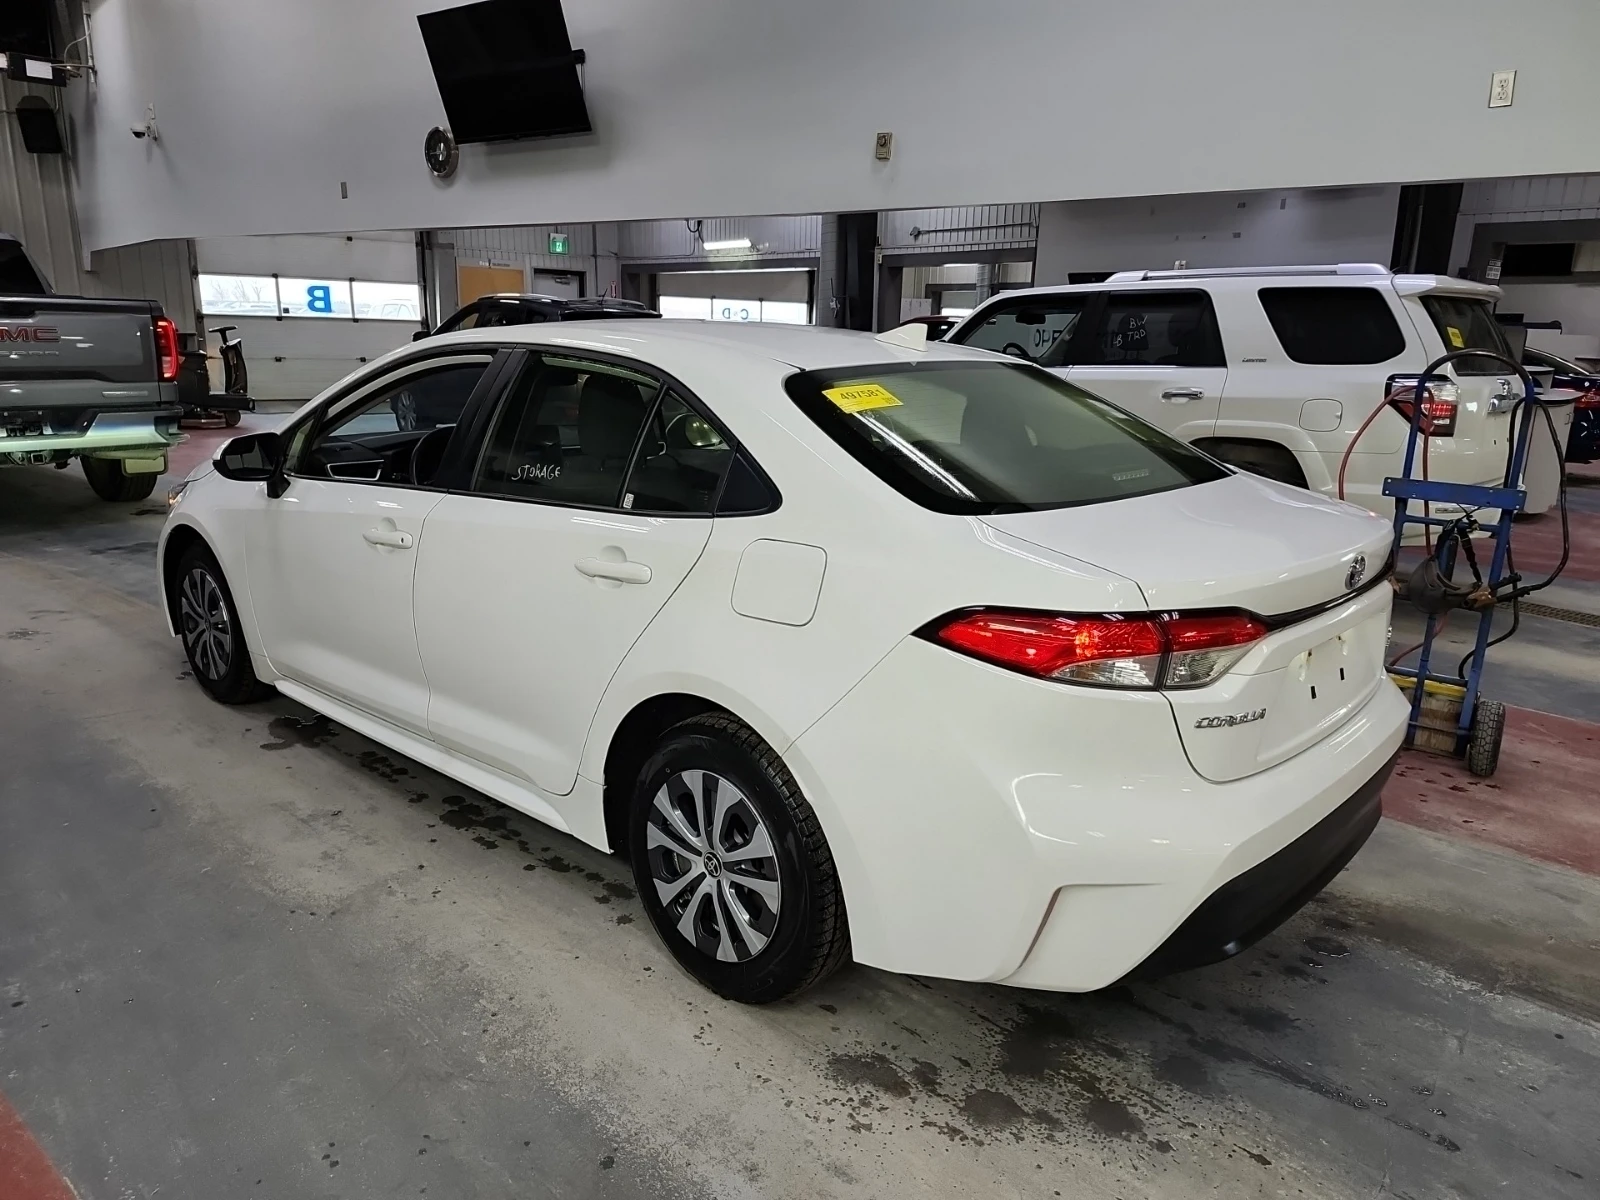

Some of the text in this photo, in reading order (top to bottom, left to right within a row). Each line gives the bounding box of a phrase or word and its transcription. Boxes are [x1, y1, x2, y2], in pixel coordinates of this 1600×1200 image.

[0, 327, 60, 342] MC
[840, 389, 884, 401] 497581
[511, 464, 561, 480] STORAGE
[1194, 708, 1267, 729] COROLLA
